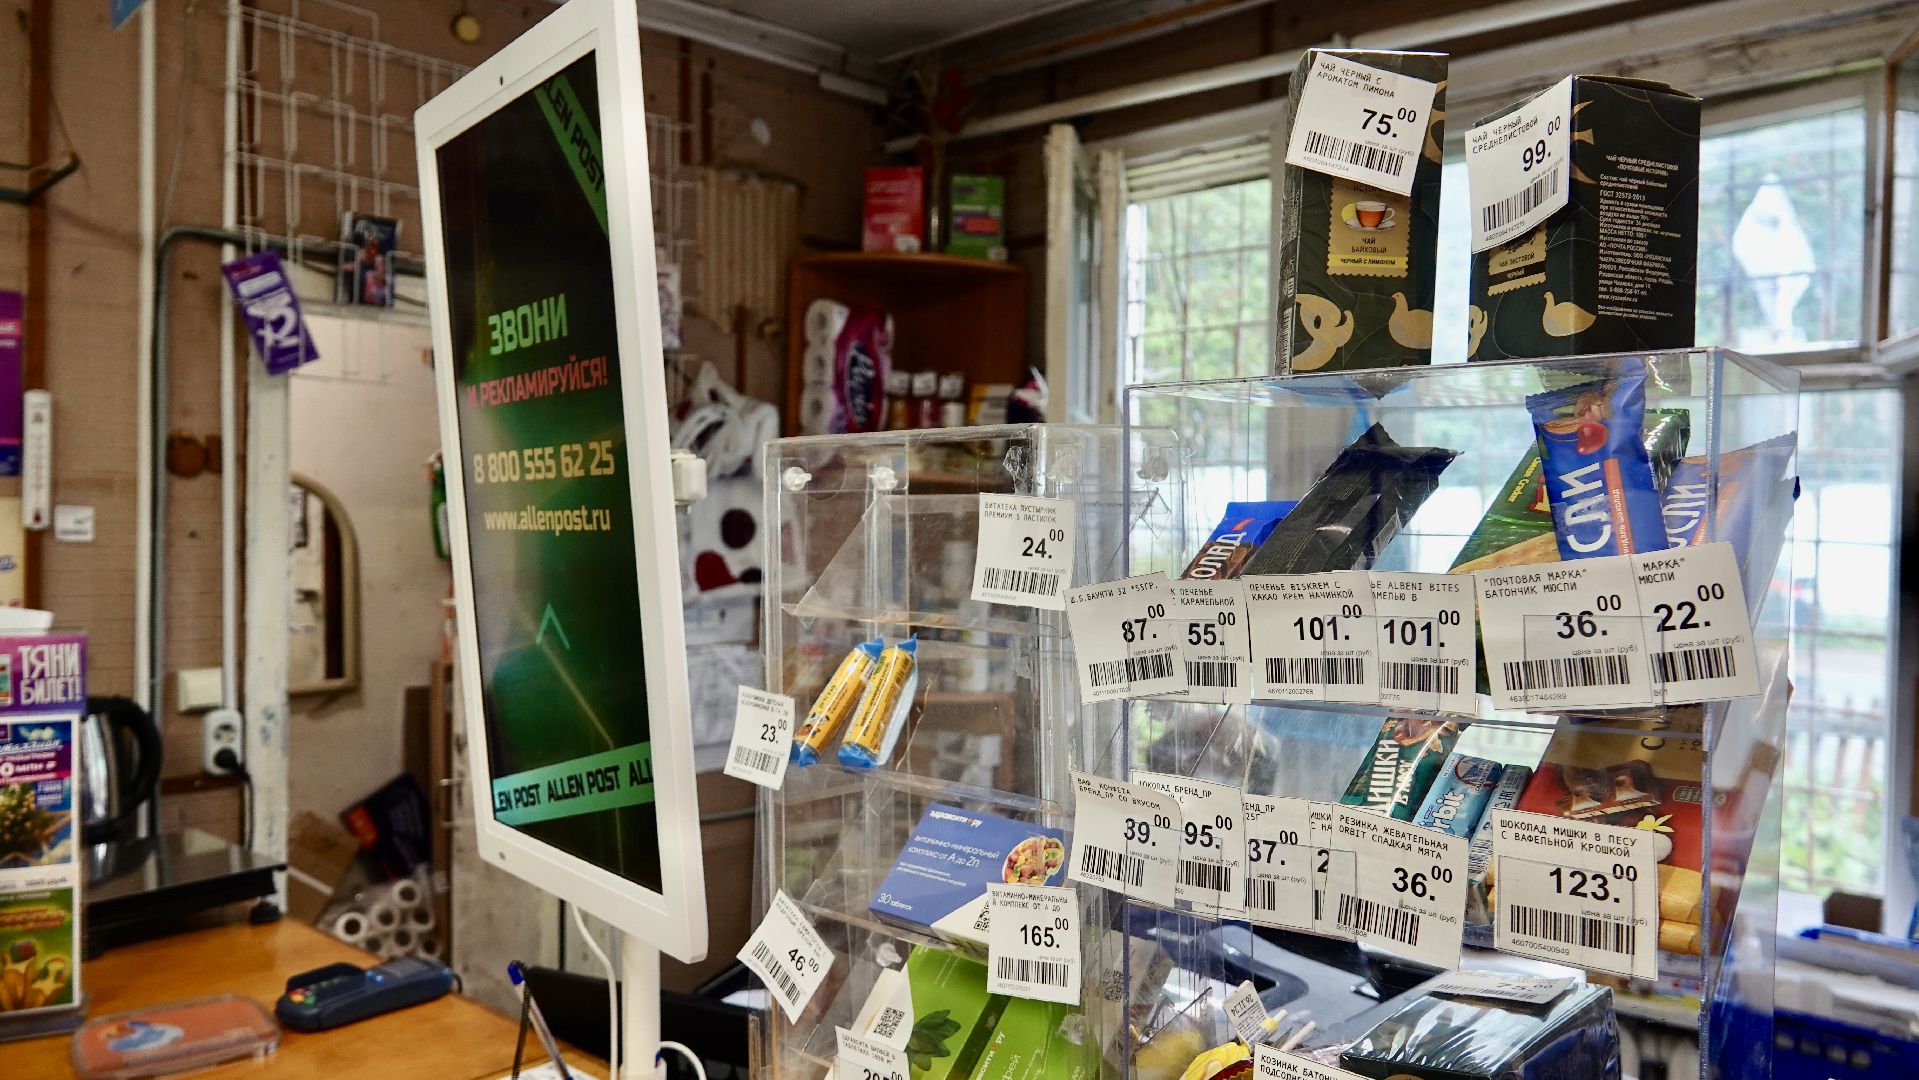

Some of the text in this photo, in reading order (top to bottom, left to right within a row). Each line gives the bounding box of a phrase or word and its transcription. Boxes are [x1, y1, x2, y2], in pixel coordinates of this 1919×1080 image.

[1320, 62, 1382, 85] ЧАЙ ЧЕРНЫЙ С
[1316, 71, 1395, 99] АРОМАТОМ ЛИМОНА
[1472, 116, 1523, 144] ЧАЙ ЧЕРНЫЙ
[1472, 117, 1538, 154] СРЕДНЕЛИСТОВОЙ
[1362, 237, 1376, 245] ЧАЙ
[1352, 246, 1387, 254] БАЙХОВЫЙ
[1341, 257, 1362, 265] ЧЕРНЫЙ
[488, 293, 568, 356] ЗВОНИ
[467, 354, 608, 410] И РЕКЛАМИРУЙСЯ!
[473, 439, 615, 484] 8 800 555 62 25
[1020, 504, 1057, 515] ПУСТЫРНИК
[1612, 488, 1625, 523] шоколад
[484, 504, 611, 537] www.allenpost.ru
[984, 511, 1013, 519] ПРЕМИУМ
[1023, 514, 1057, 523] ПАСТИЛОК
[1642, 558, 1686, 571] МАРКА"
[1547, 568, 1587, 581] МАРКА"
[1638, 572, 1676, 585] МЮСЛИ
[1117, 587, 1127, 596] 32
[1180, 588, 1213, 596] ПЕЧЕНЬЕ
[1250, 583, 1286, 592] ПЕЧЕНЬЕ
[1290, 582, 1330, 591] BISKREM
[1388, 581, 1423, 591] ALBENI
[1430, 583, 1460, 593] BITES
[1485, 582, 1578, 599] БАТОНЧИК МЮСЛИ
[1252, 588, 1354, 601] КАКАО КРЕМ НАЧИНКОЙ
[1180, 597, 1235, 606] КАРАМЕЛЬНОЙ
[1722, 635, 1745, 645] (руб)
[1617, 645, 1639, 655] (руб)
[18, 643, 80, 679] ТЯНИ
[20, 677, 82, 705] БИЛЕТ!
[514, 783, 541, 809] POST
[547, 773, 585, 803] ALLEN
[587, 765, 620, 795] POST
[1099, 783, 1131, 795] КОНФЕТА
[1174, 786, 1212, 798] БРЕНД_ПР
[1079, 786, 1161, 811] БРЕНД_ПР СО ВКУСОМ
[1339, 815, 1448, 851] РЕЗИНКА ЖЕВАТЕЛЬНАЯ
[1500, 820, 1637, 847] ШОКОЛАД МИШКИ В ЛЕСУ
[1339, 827, 1442, 860] ORBIT СЛАДКАЯ МЯТА
[1501, 831, 1631, 858] С ВАФЕЛЬНОЙ КРОШКОЙ
[877, 892, 892, 905] 30
[992, 891, 1068, 904] ВИТАМИННО-МИНЕРАЛЬНЫ
[1000, 900, 1029, 909] КОМПЛЕКС
[1581, 909, 1600, 918] цена
[1627, 916, 1648, 926] (руб)
[1261, 1054, 1298, 1073] КОЗИНАК
